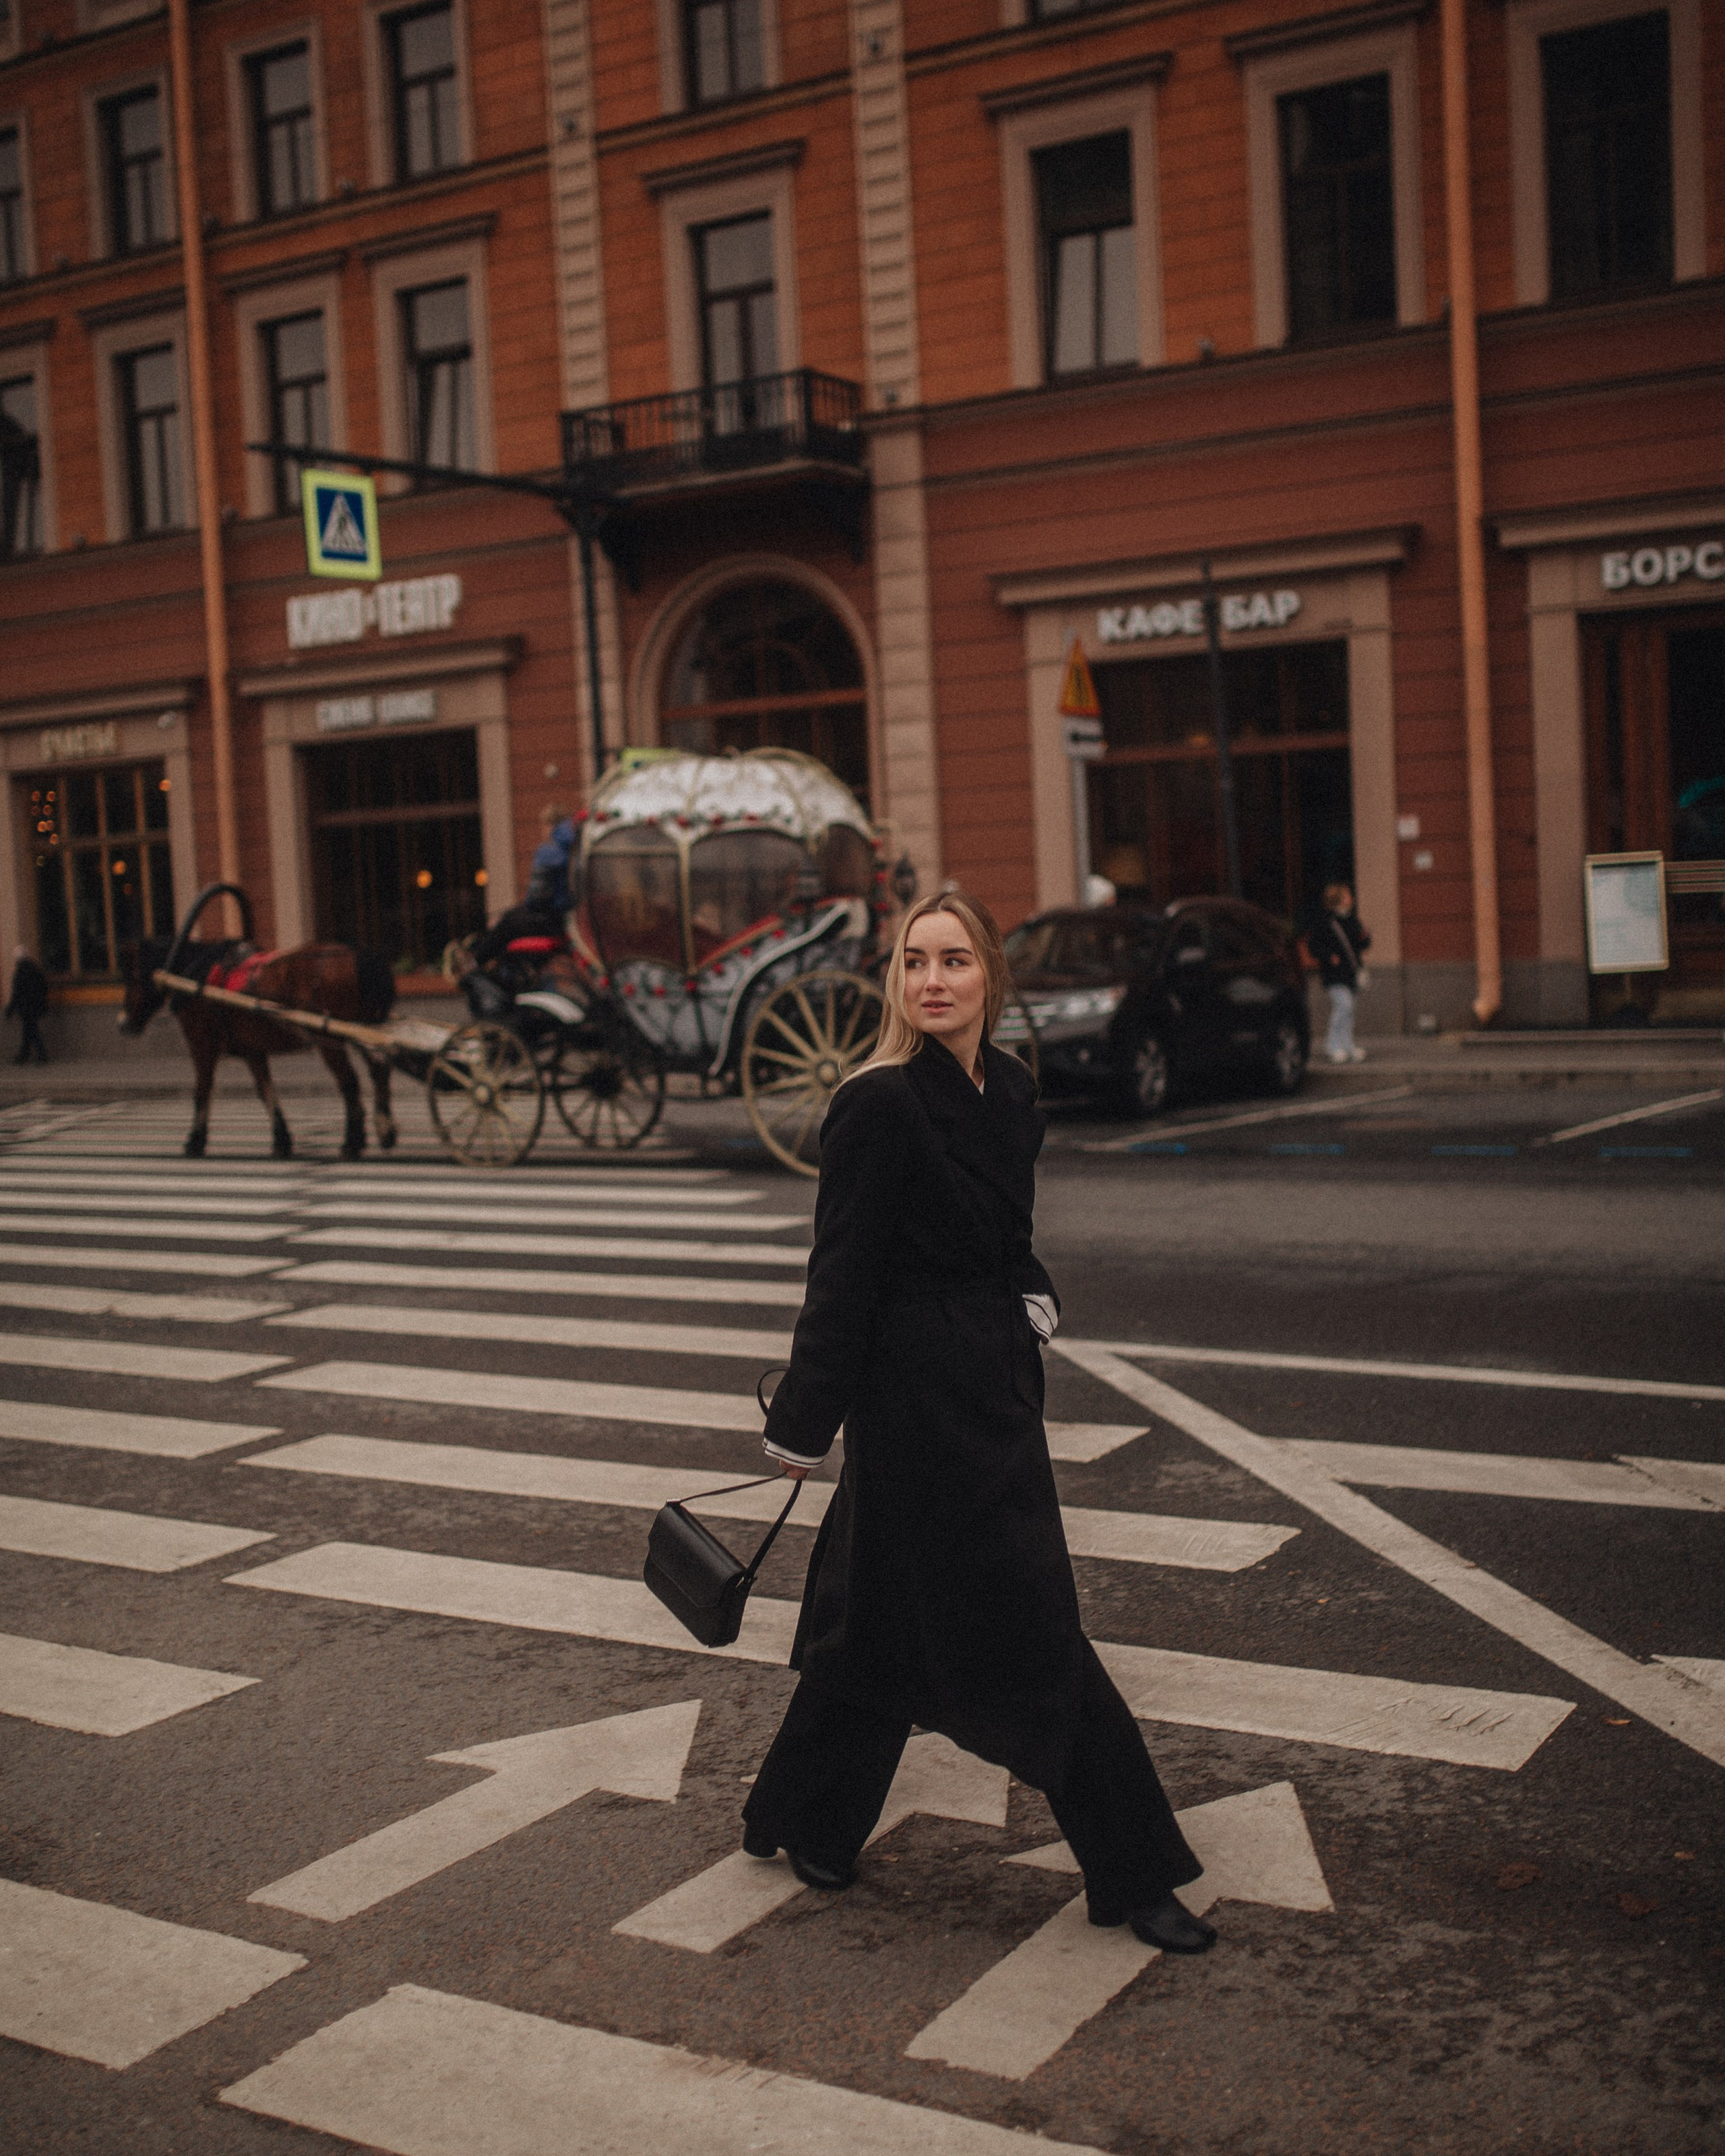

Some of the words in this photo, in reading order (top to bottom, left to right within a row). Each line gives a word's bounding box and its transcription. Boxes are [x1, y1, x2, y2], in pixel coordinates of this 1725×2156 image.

[1601, 541, 1725, 590] БОРС
[1097, 599, 1205, 642] КАФЕ
[1220, 589, 1301, 632] БАР
